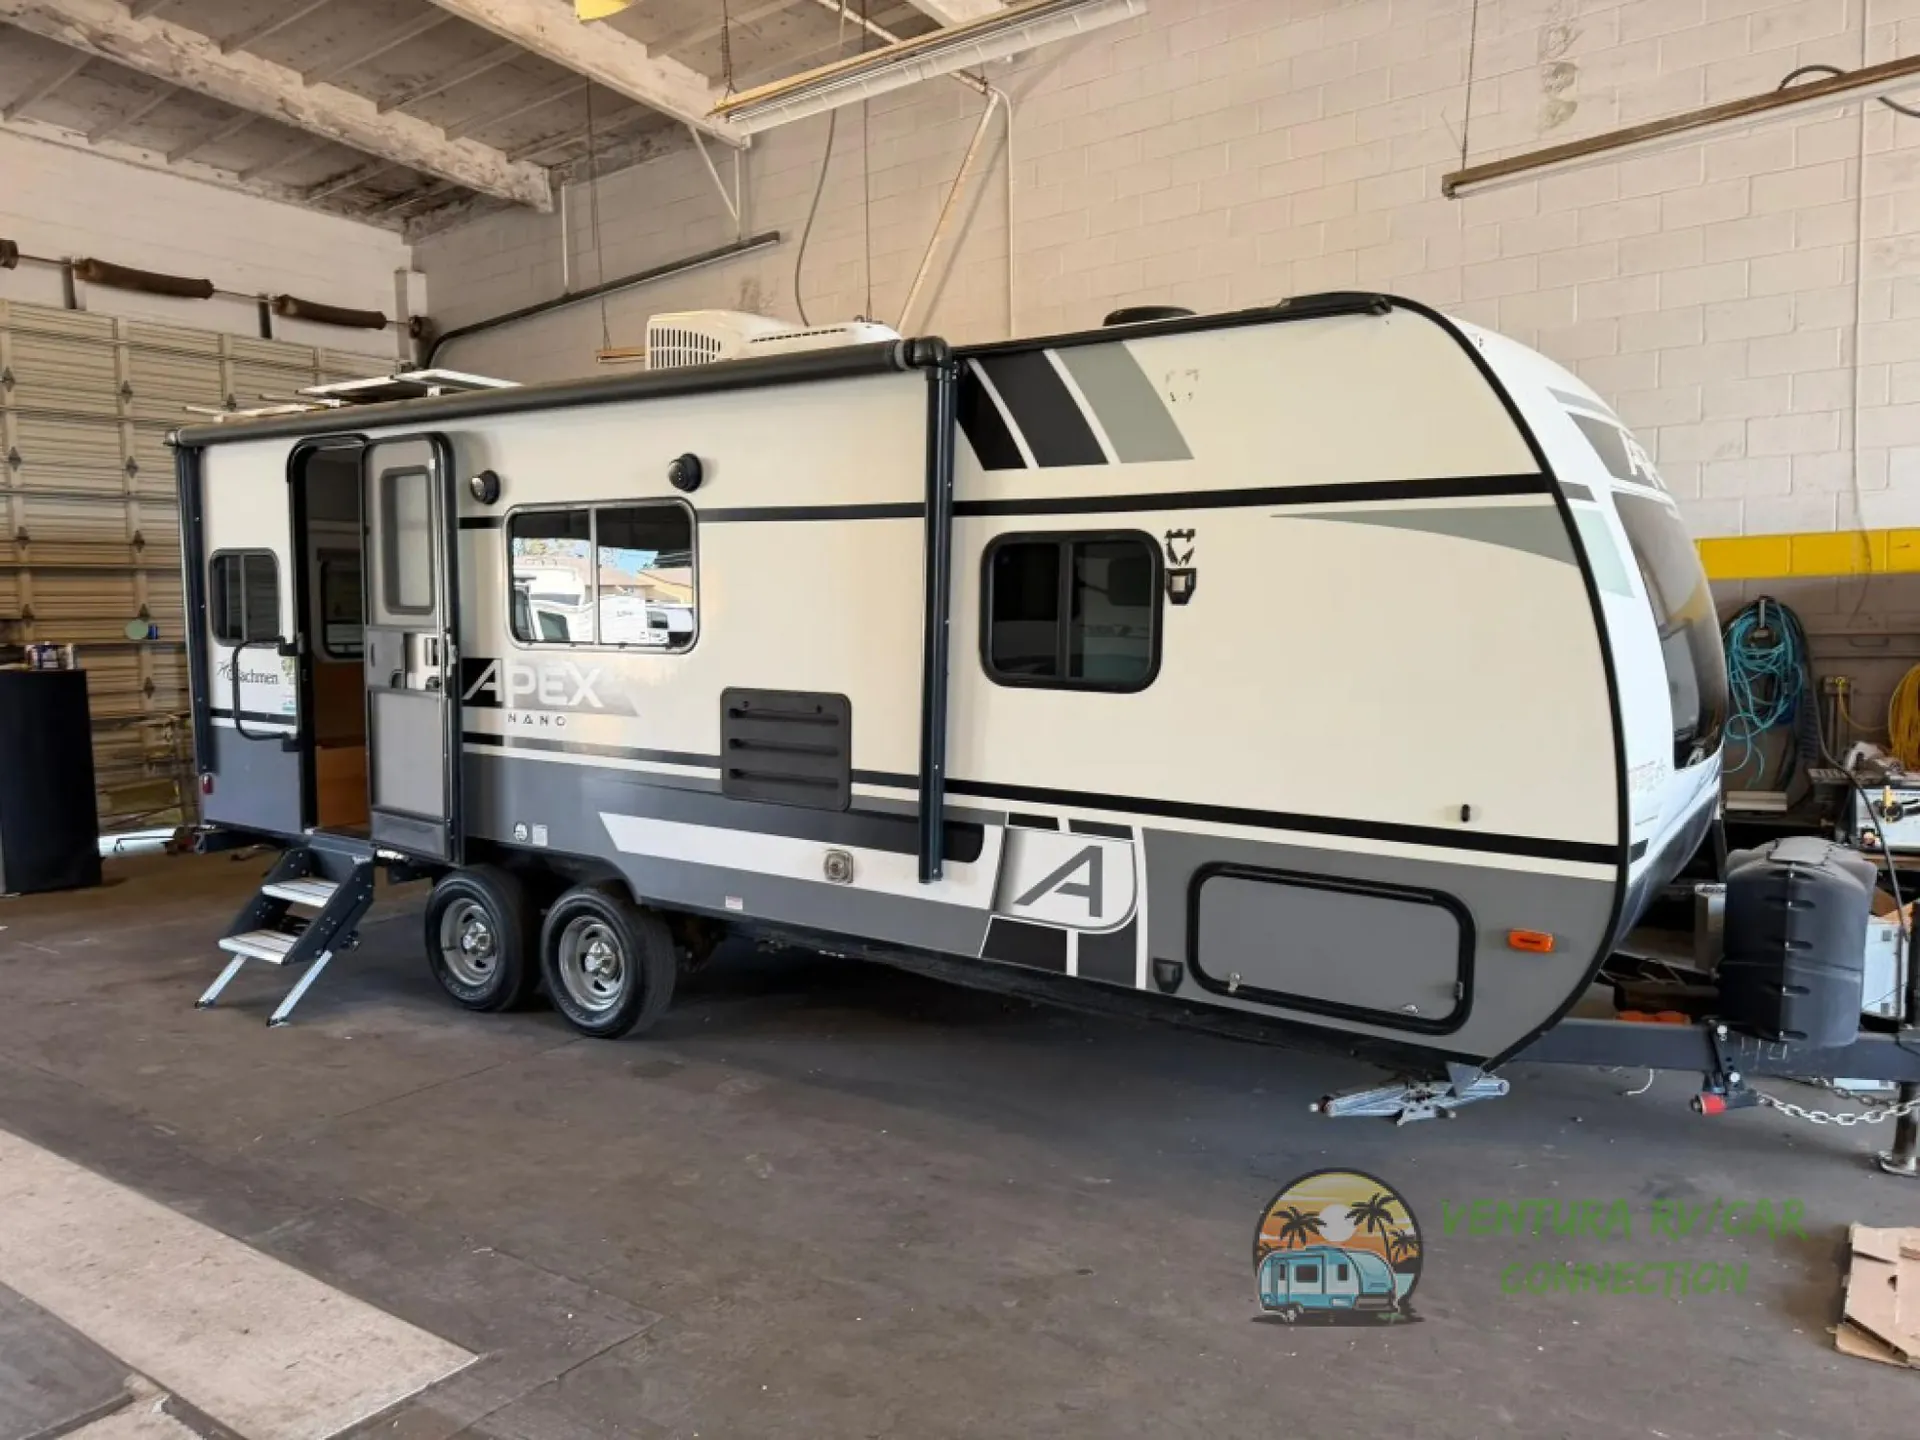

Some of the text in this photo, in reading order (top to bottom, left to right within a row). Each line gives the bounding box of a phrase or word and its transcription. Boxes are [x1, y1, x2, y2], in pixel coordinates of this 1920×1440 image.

[224, 666, 279, 685] Cachmen
[461, 658, 604, 708] APEX
[507, 712, 567, 727] NANO
